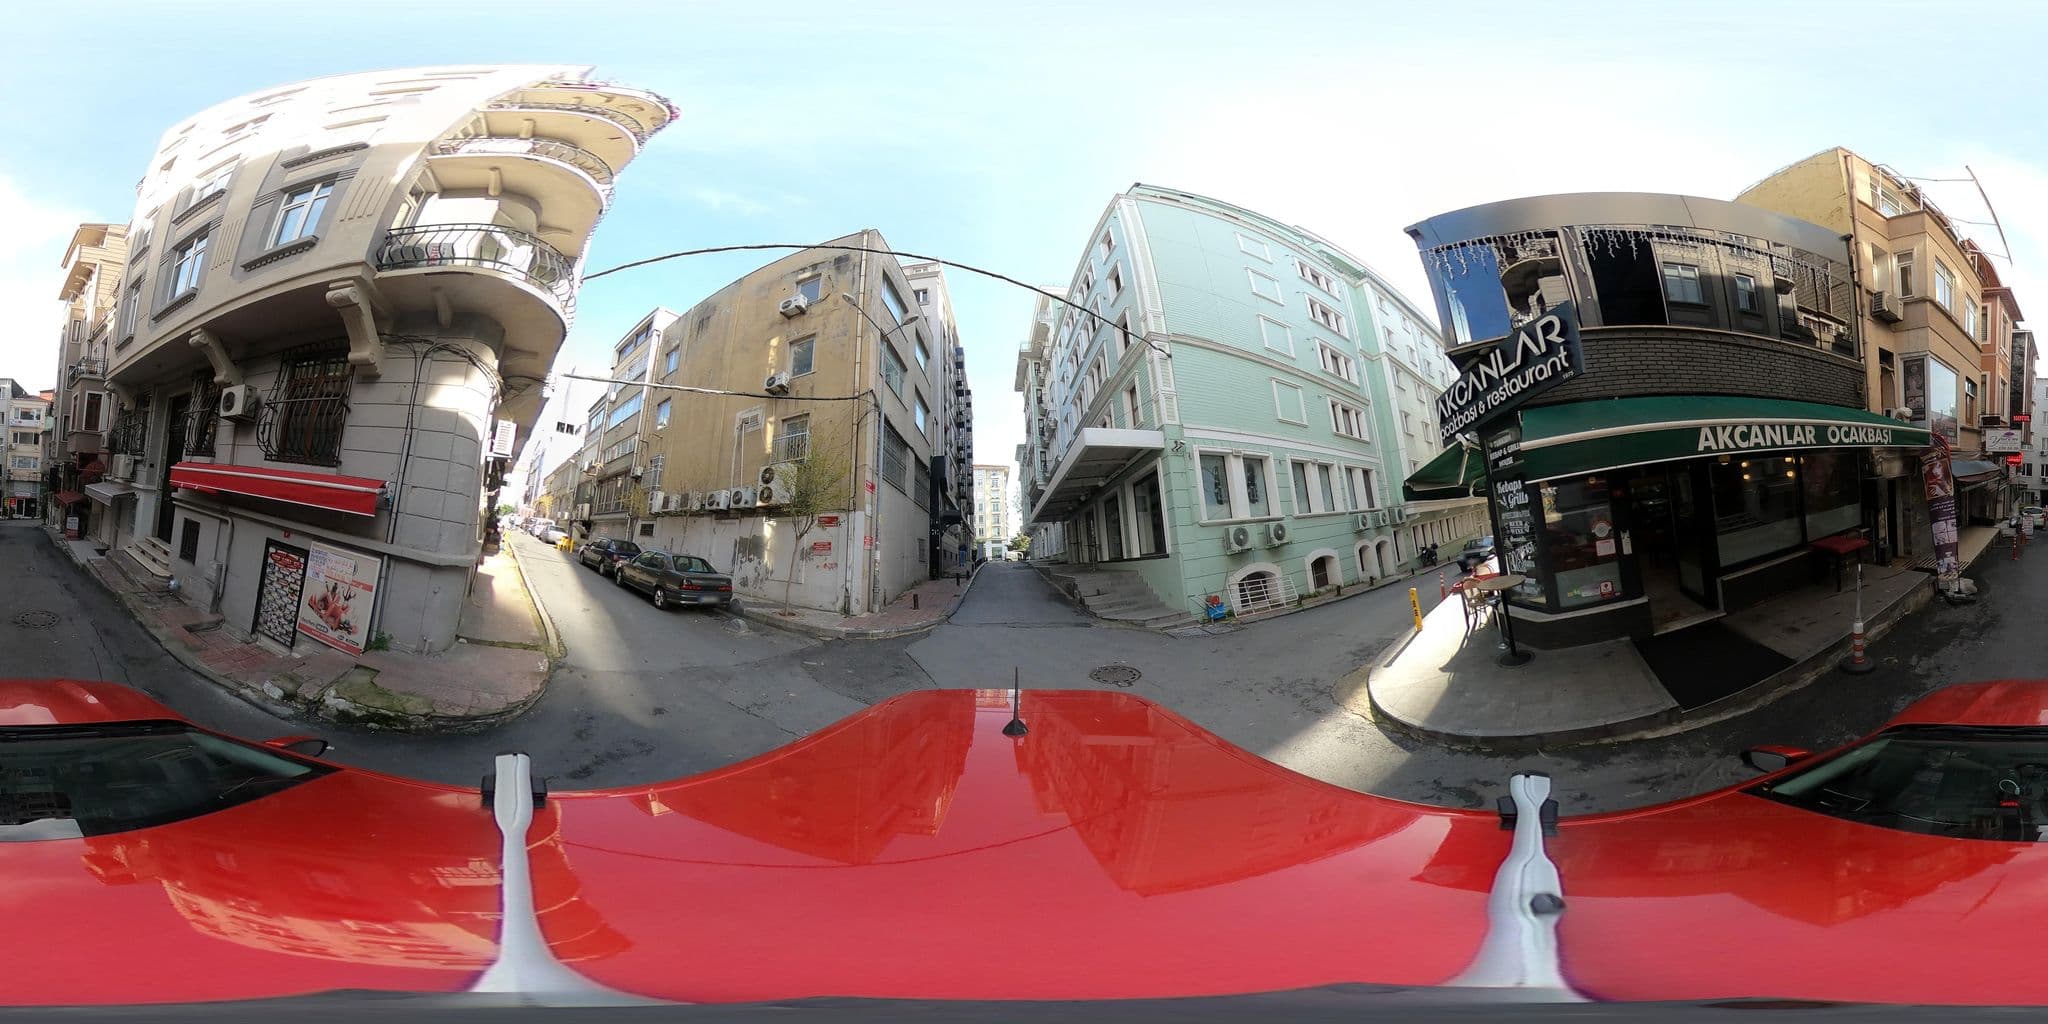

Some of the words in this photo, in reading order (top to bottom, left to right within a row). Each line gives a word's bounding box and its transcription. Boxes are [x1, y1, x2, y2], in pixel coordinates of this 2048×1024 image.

[1438, 315, 1566, 419] AKCANLAR
[1486, 345, 1570, 410] restaurant
[1698, 425, 1816, 451] AKCANLAR
[1827, 426, 1892, 444] OCAKBAŞI
